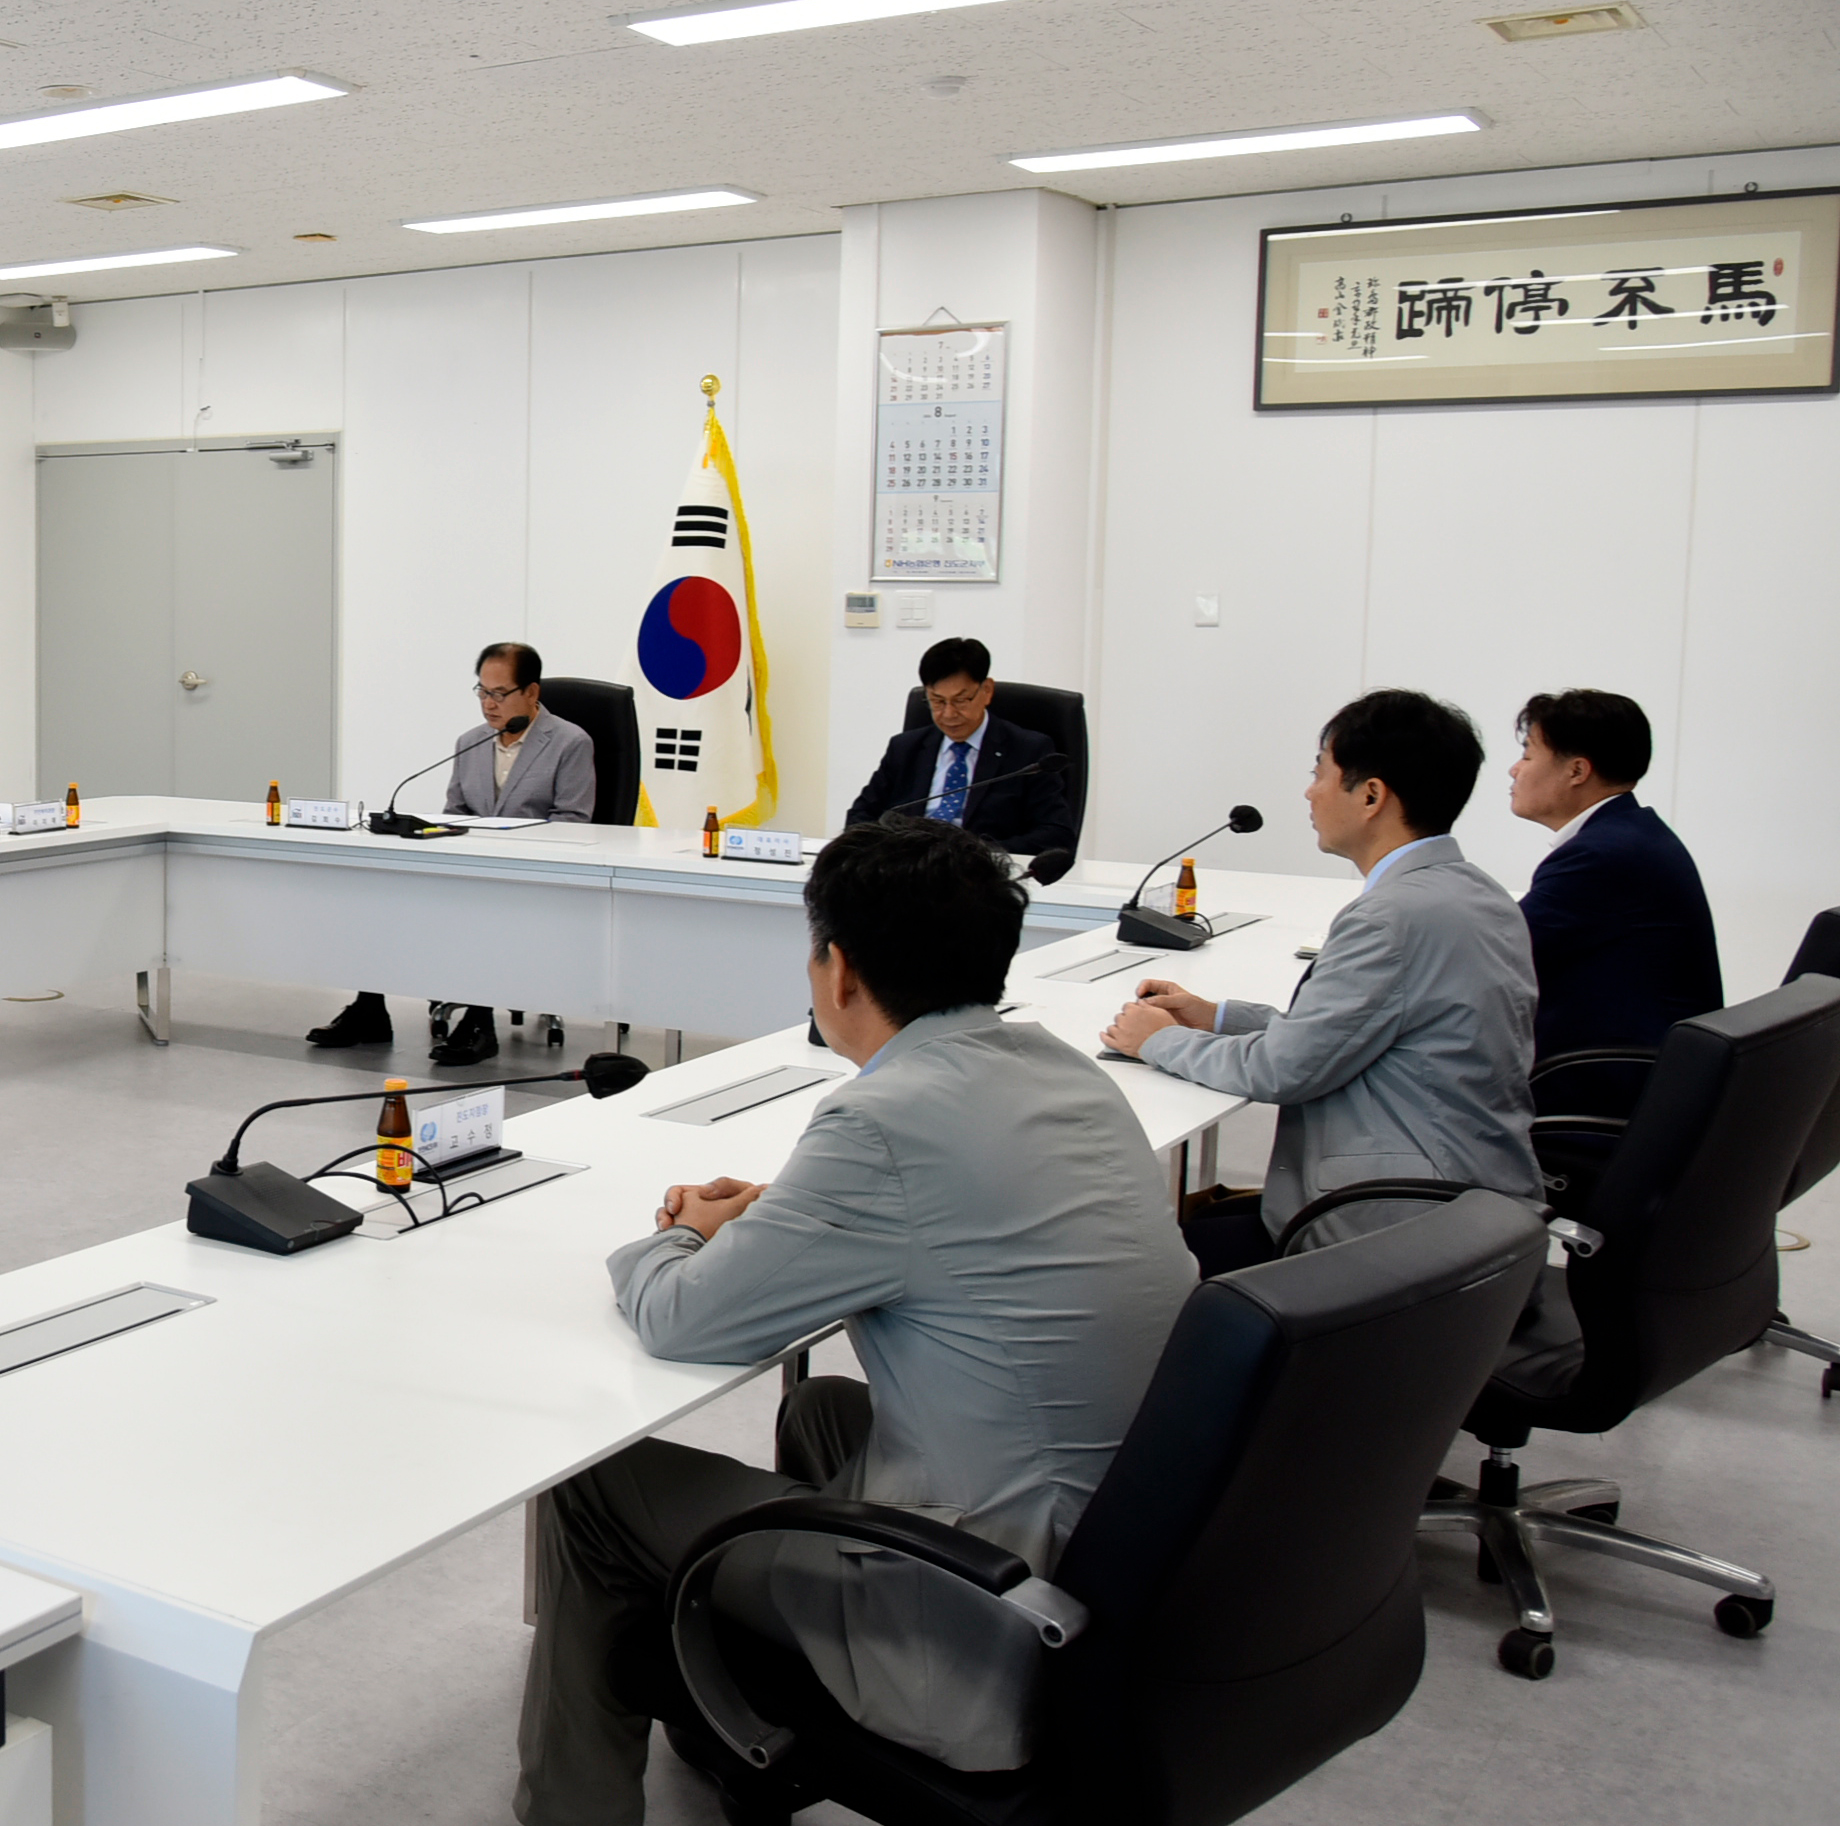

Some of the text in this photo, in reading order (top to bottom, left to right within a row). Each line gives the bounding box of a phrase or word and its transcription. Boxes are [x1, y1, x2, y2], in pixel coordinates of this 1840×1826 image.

[935, 406, 942, 417] 8
[952, 426, 956, 434] 1
[967, 426, 972, 434] 2
[905, 440, 910, 448] 5
[935, 440, 941, 448] 7
[951, 439, 956, 447] 8
[903, 453, 912, 461] 12
[919, 453, 927, 461] 13
[949, 452, 957, 460] 15
[965, 452, 973, 460] 16
[903, 466, 911, 474] 19
[917, 466, 926, 474] 20
[932, 466, 941, 474] 21
[948, 465, 957, 473] 22
[963, 465, 973, 473] 23
[979, 465, 989, 473] 24
[887, 479, 896, 487] 25
[902, 479, 911, 487] 26
[917, 479, 926, 487] 27
[963, 478, 972, 486] 30
[978, 478, 987, 486] 31
